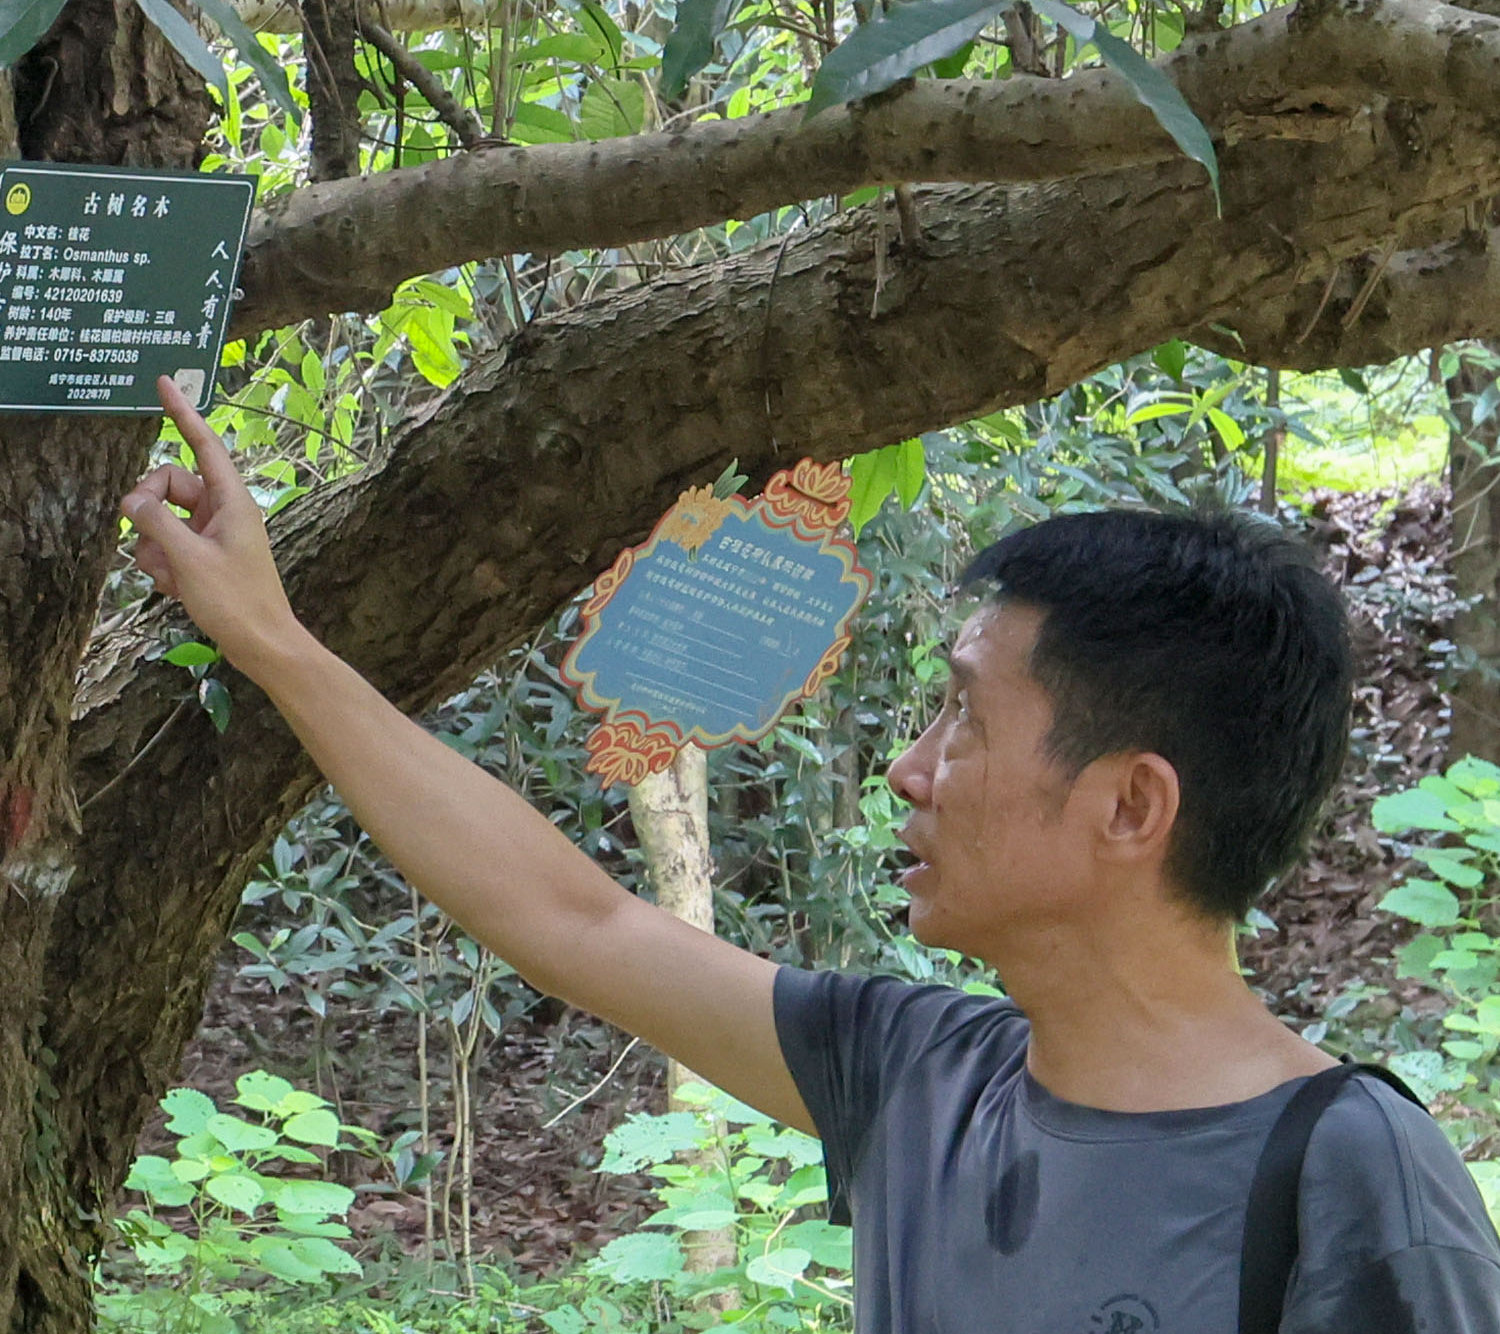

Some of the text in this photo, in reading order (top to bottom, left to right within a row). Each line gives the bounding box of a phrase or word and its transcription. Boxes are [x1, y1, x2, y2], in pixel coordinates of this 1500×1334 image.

[83, 191, 171, 218] 古树名木
[133, 252, 151, 266] sp.
